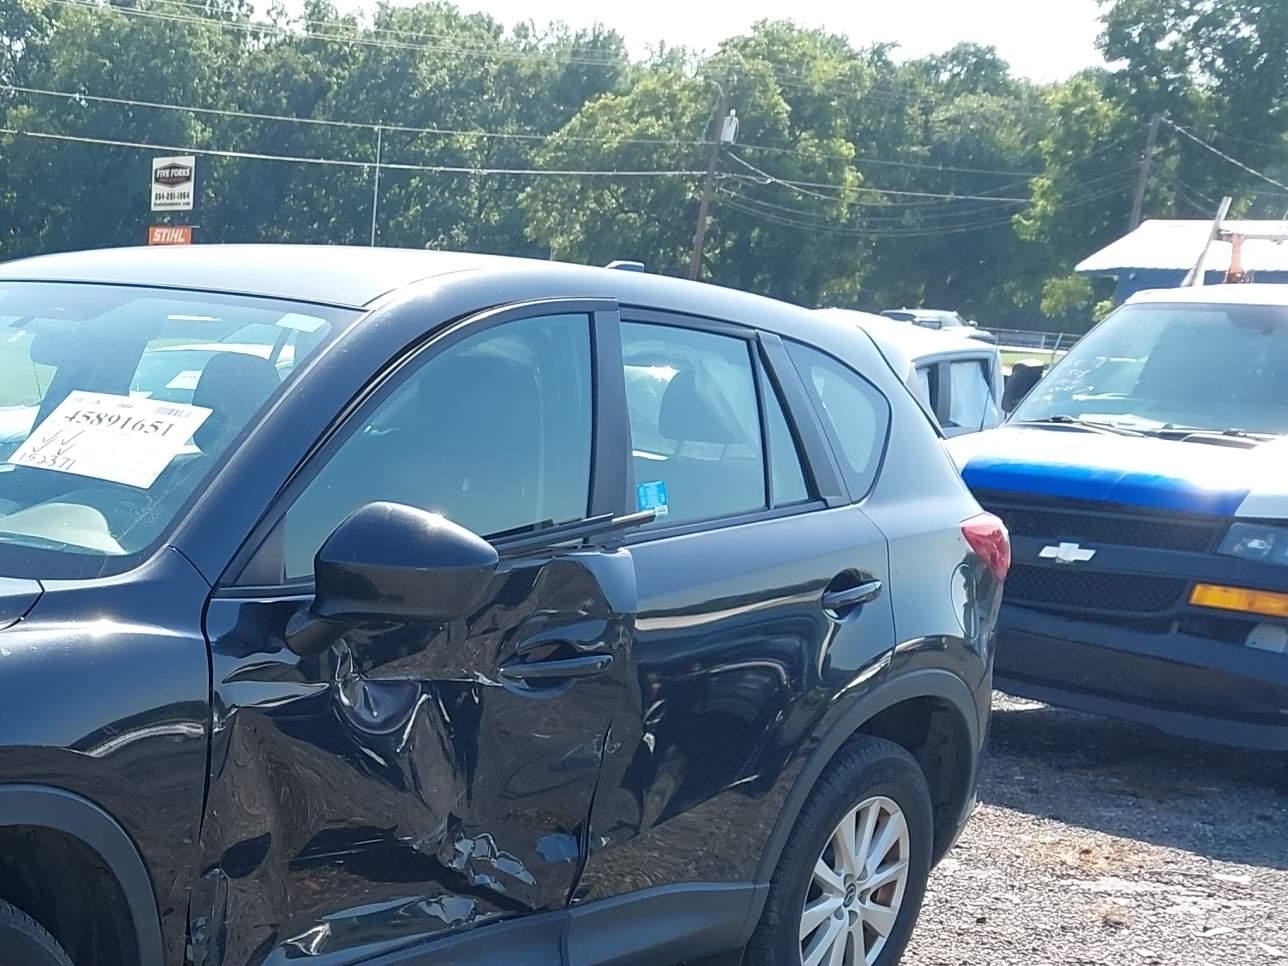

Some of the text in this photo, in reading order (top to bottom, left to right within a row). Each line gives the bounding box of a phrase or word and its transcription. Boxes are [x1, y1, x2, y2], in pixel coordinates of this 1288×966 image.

[156, 168, 190, 178] FIVE FORKS
[153, 228, 185, 243] STIHL
[64, 410, 175, 437] 45891651
